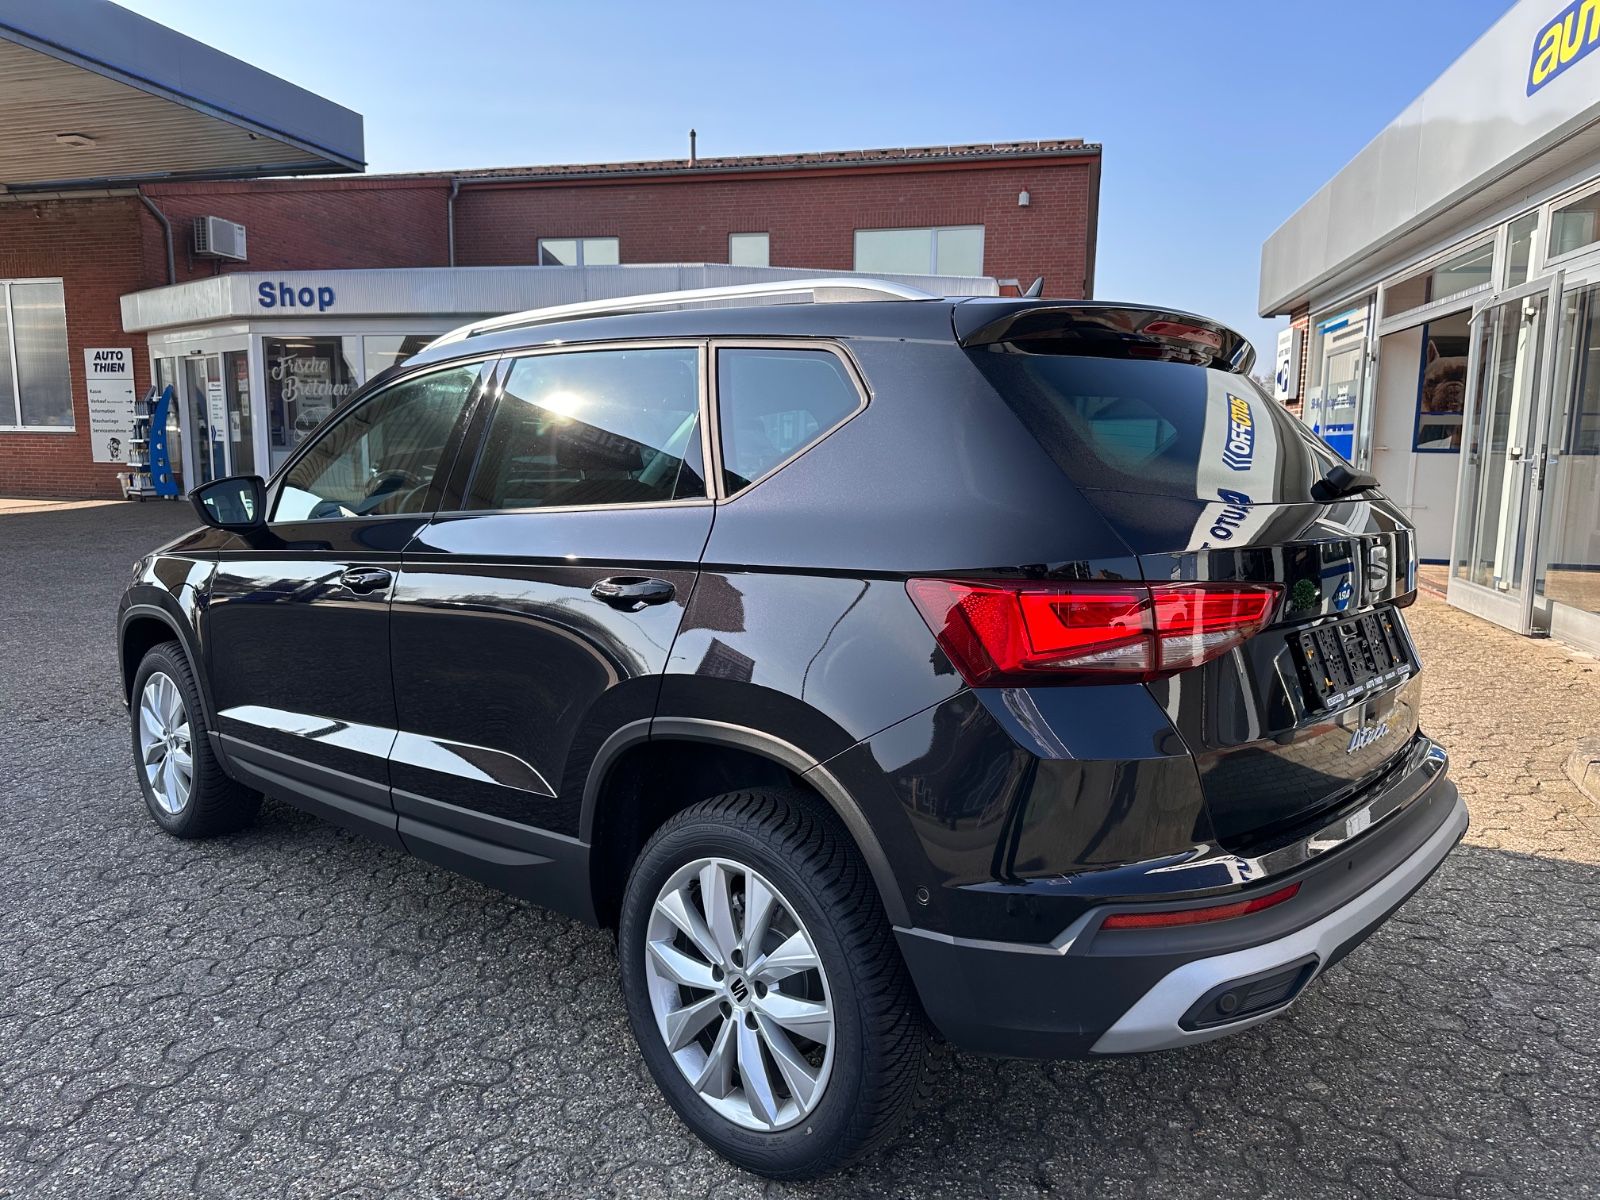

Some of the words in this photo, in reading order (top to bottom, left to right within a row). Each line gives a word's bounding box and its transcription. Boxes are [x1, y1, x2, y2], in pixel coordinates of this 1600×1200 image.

[258, 281, 336, 312] Shop
[94, 350, 124, 361] AUTO
[93, 363, 125, 373] THIEN
[272, 353, 328, 380] Frische
